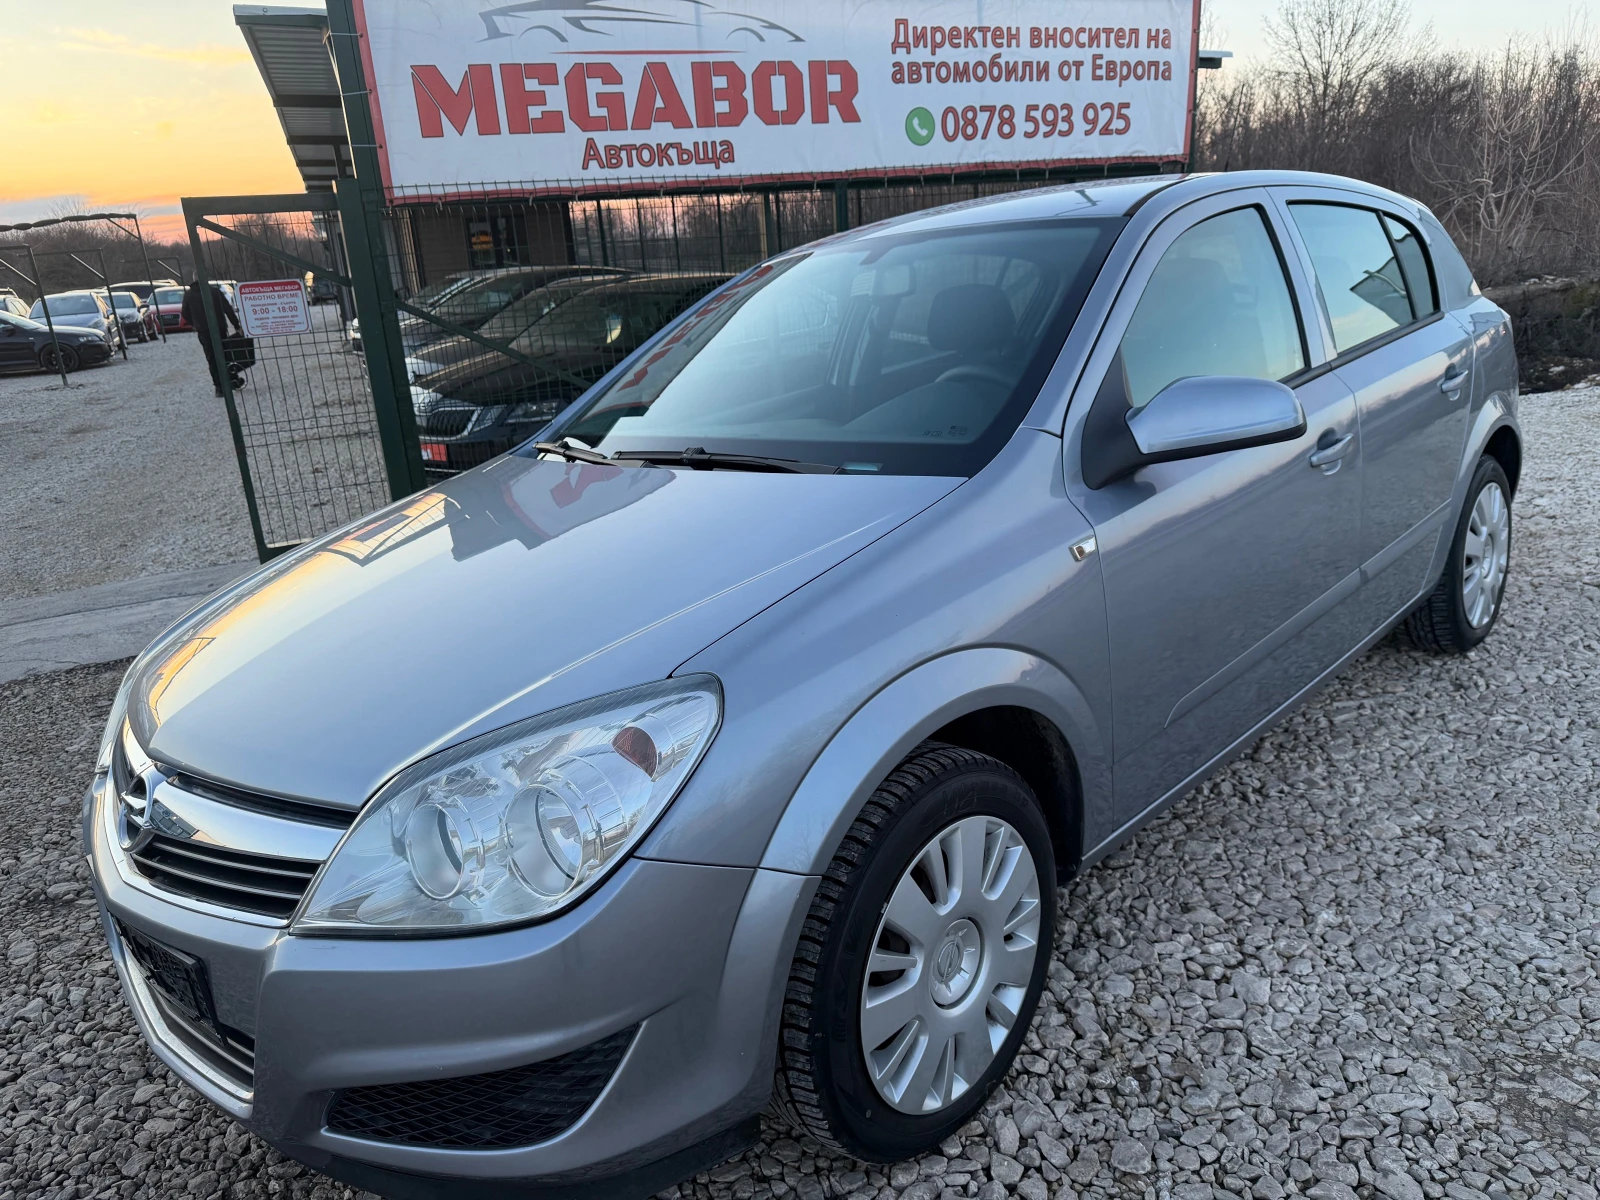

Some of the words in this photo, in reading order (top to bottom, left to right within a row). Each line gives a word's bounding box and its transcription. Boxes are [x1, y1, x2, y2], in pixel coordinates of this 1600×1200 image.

[891, 18, 1020, 56] Директен
[1029, 26, 1139, 49] вносител
[1146, 28, 1172, 50] на
[891, 53, 1050, 84] автомобили
[1058, 59, 1084, 82] от
[1091, 54, 1172, 87] Европа
[410, 60, 862, 138] MEGABOR
[941, 104, 1016, 142] 0878
[1023, 103, 1074, 139] 593
[1083, 102, 1131, 137] 925
[581, 137, 735, 171] Автокъща
